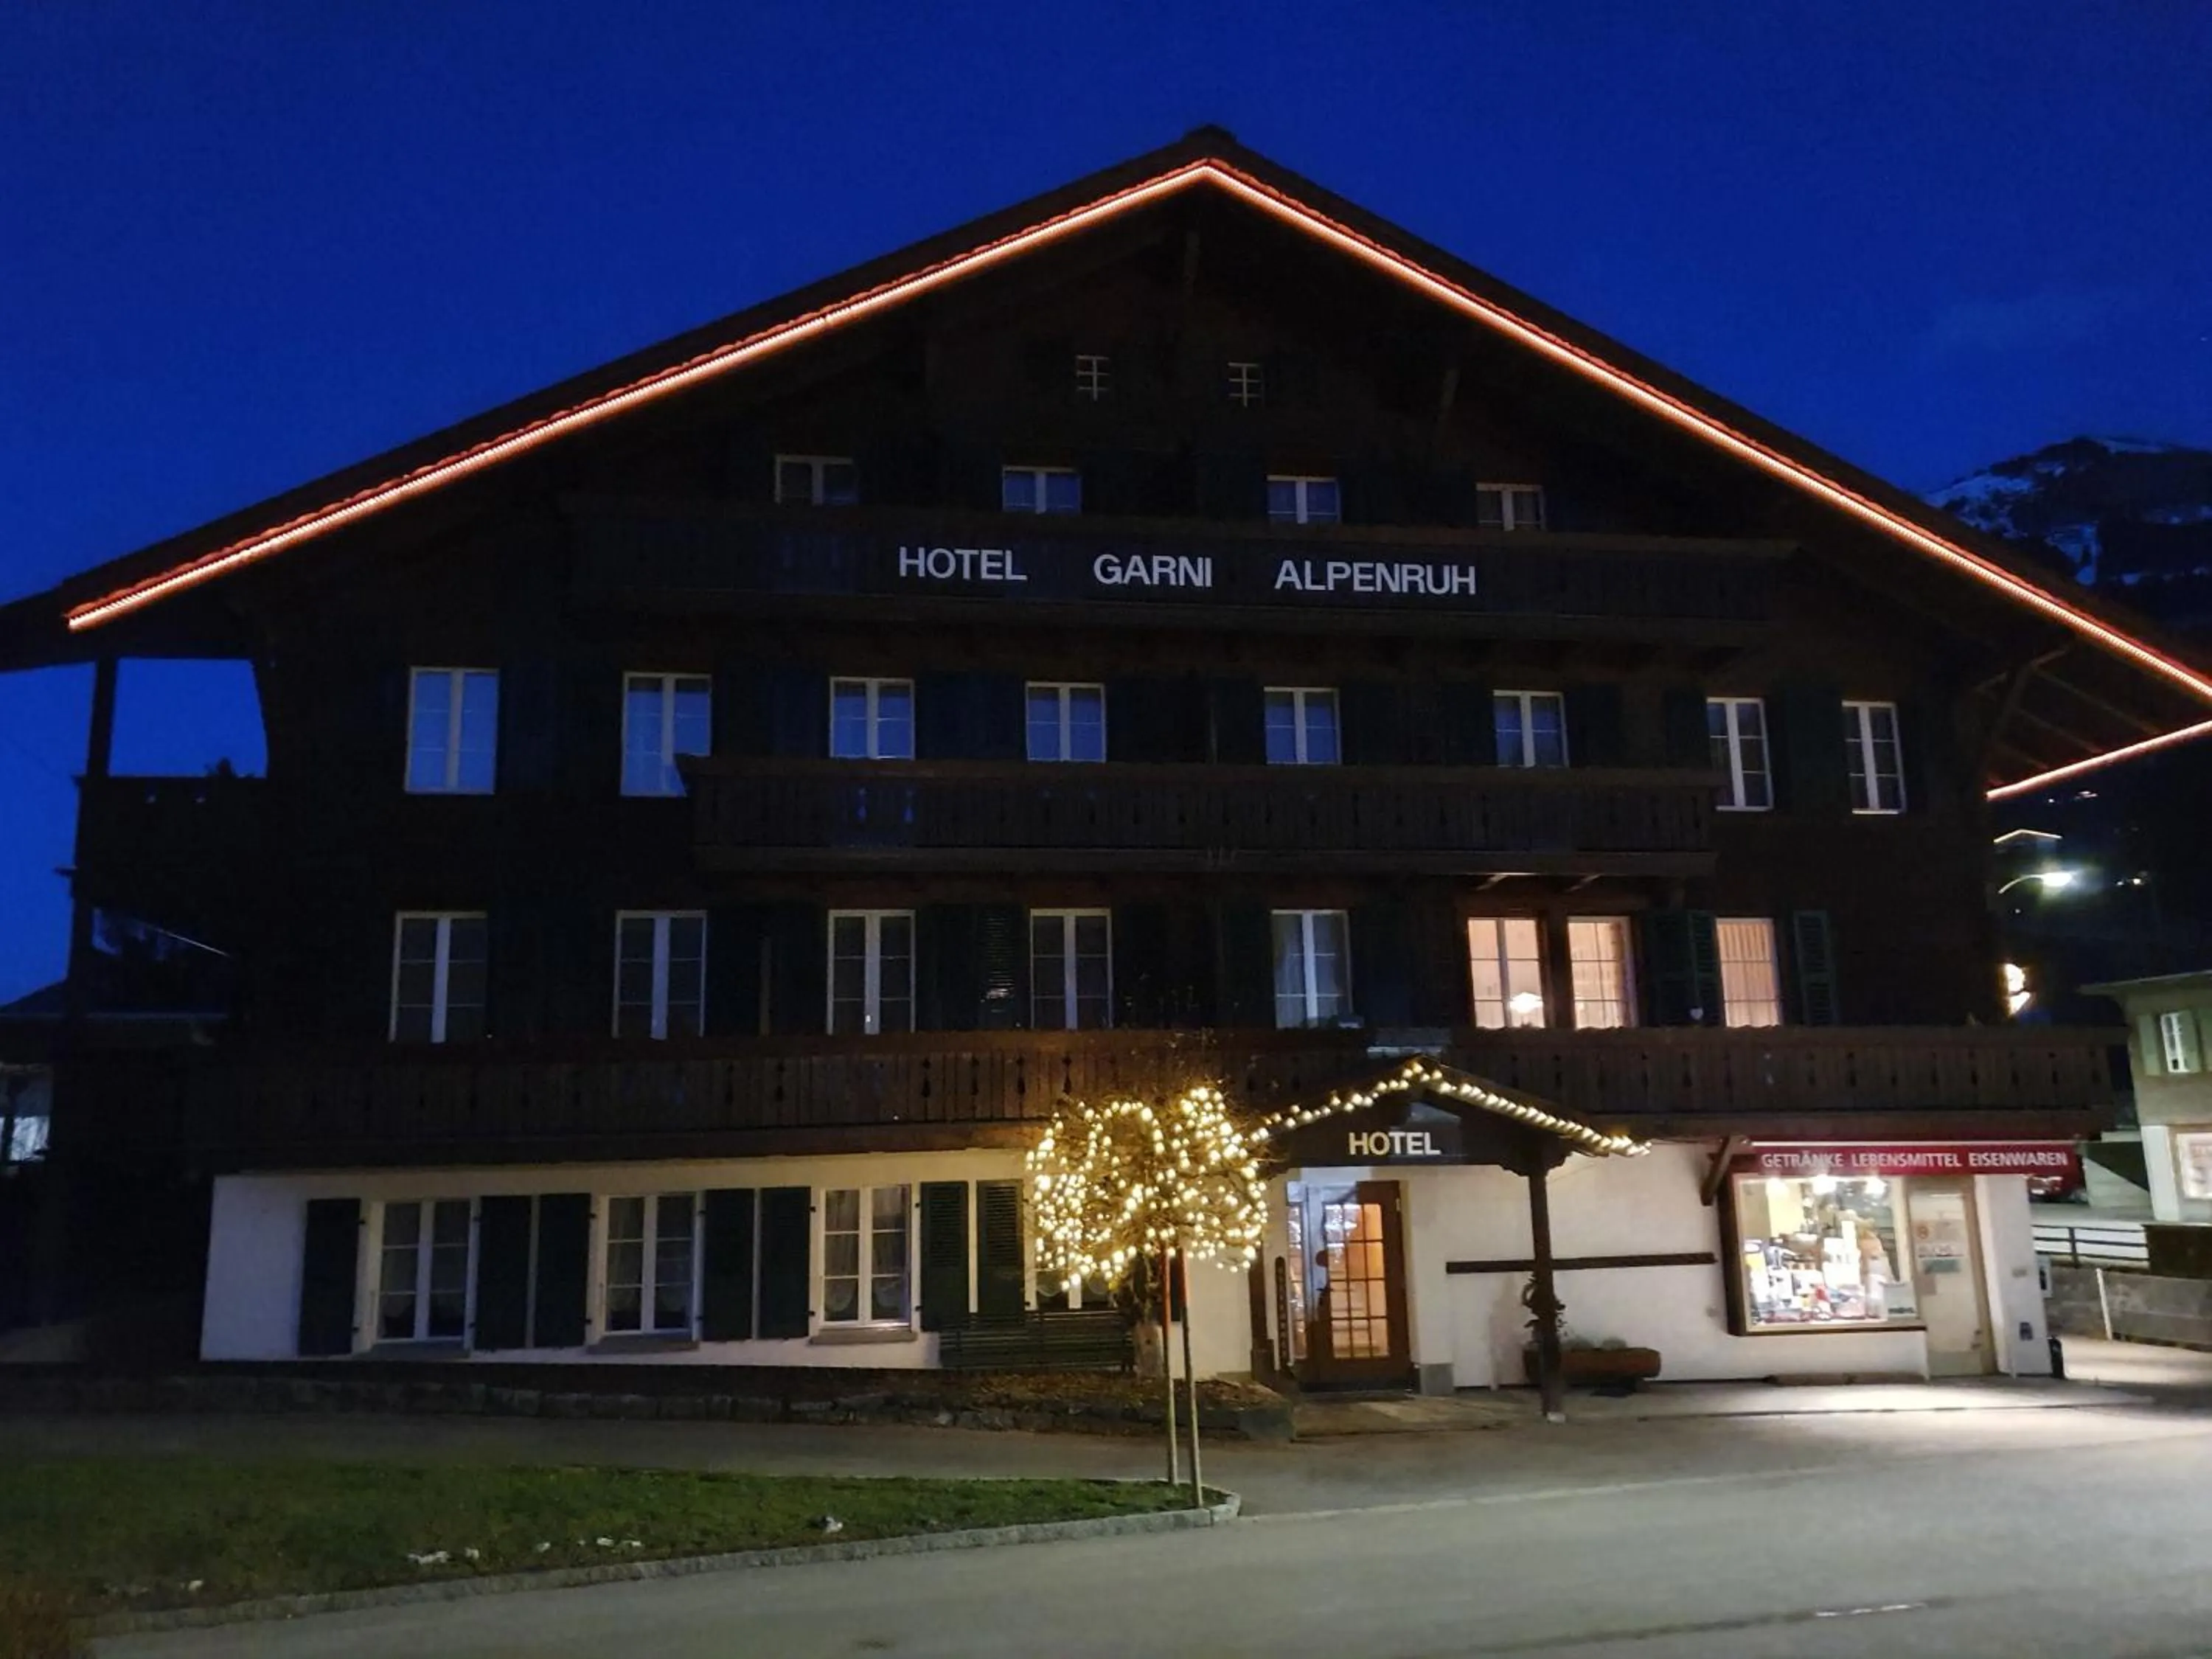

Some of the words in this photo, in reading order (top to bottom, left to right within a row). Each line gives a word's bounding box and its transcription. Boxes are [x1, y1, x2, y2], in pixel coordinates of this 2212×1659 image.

[898, 546, 1028, 581] HOTEL
[1093, 554, 1213, 588] GARNI
[1274, 560, 1475, 595] ALPENRUH
[1349, 1131, 1441, 1155] HOTEL
[1761, 1150, 1843, 1168] GETRÄNKE
[1851, 1152, 1962, 1167] LEBENSMITTEL
[1969, 1152, 2068, 1166] EISENWAREN
